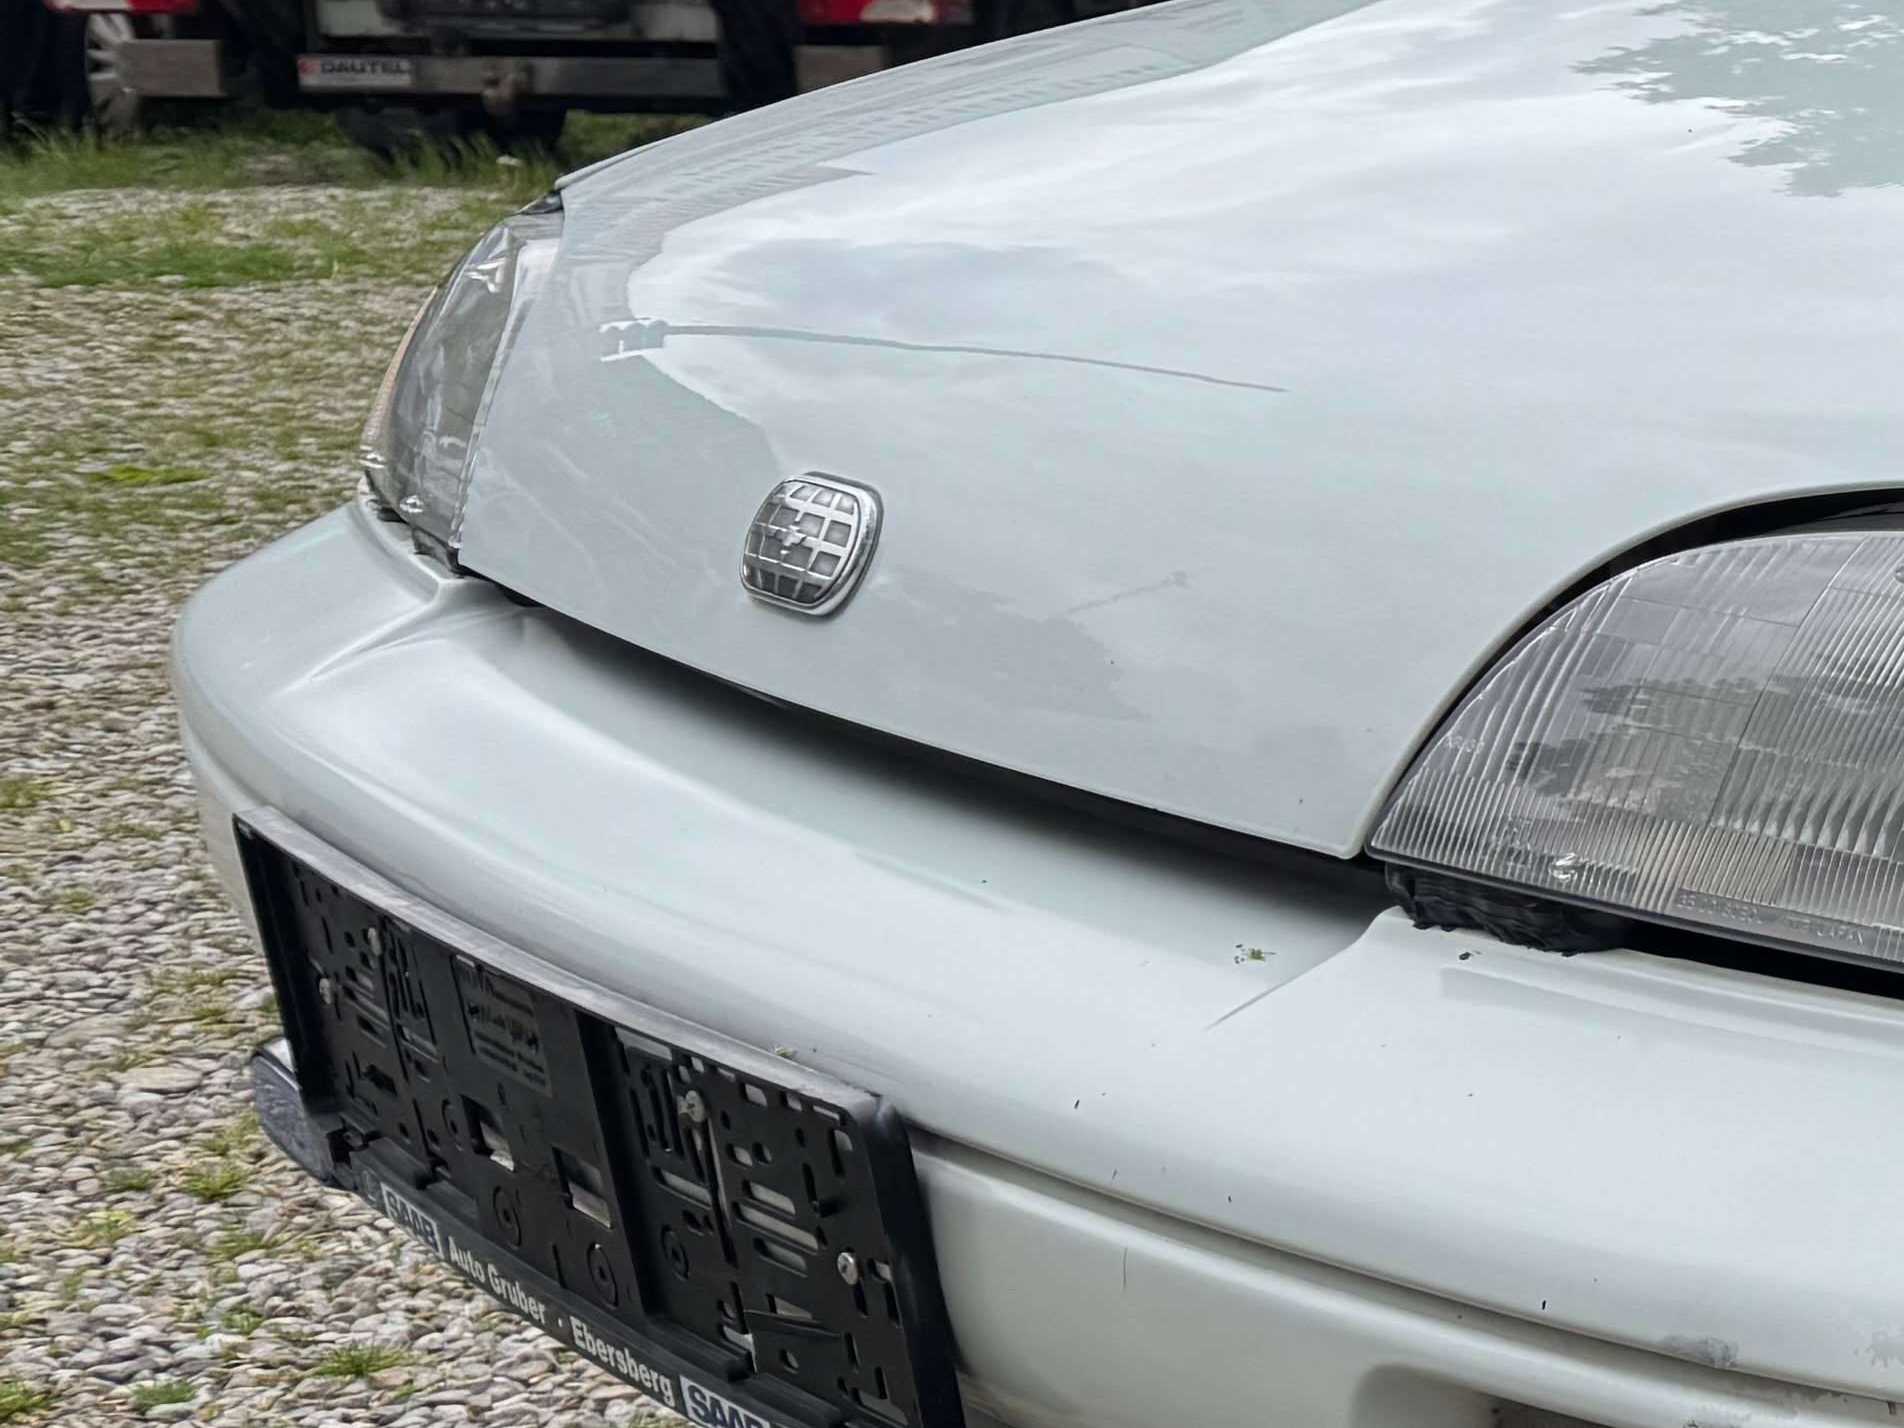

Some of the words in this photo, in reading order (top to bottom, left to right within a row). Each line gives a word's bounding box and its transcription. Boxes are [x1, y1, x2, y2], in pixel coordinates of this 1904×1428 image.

[320, 58, 409, 75] DAUTEL
[385, 1186, 441, 1257] SAAB
[448, 1235, 486, 1284] Auto
[487, 1262, 546, 1325] Gruber
[569, 1315, 676, 1408] Ebersberg
